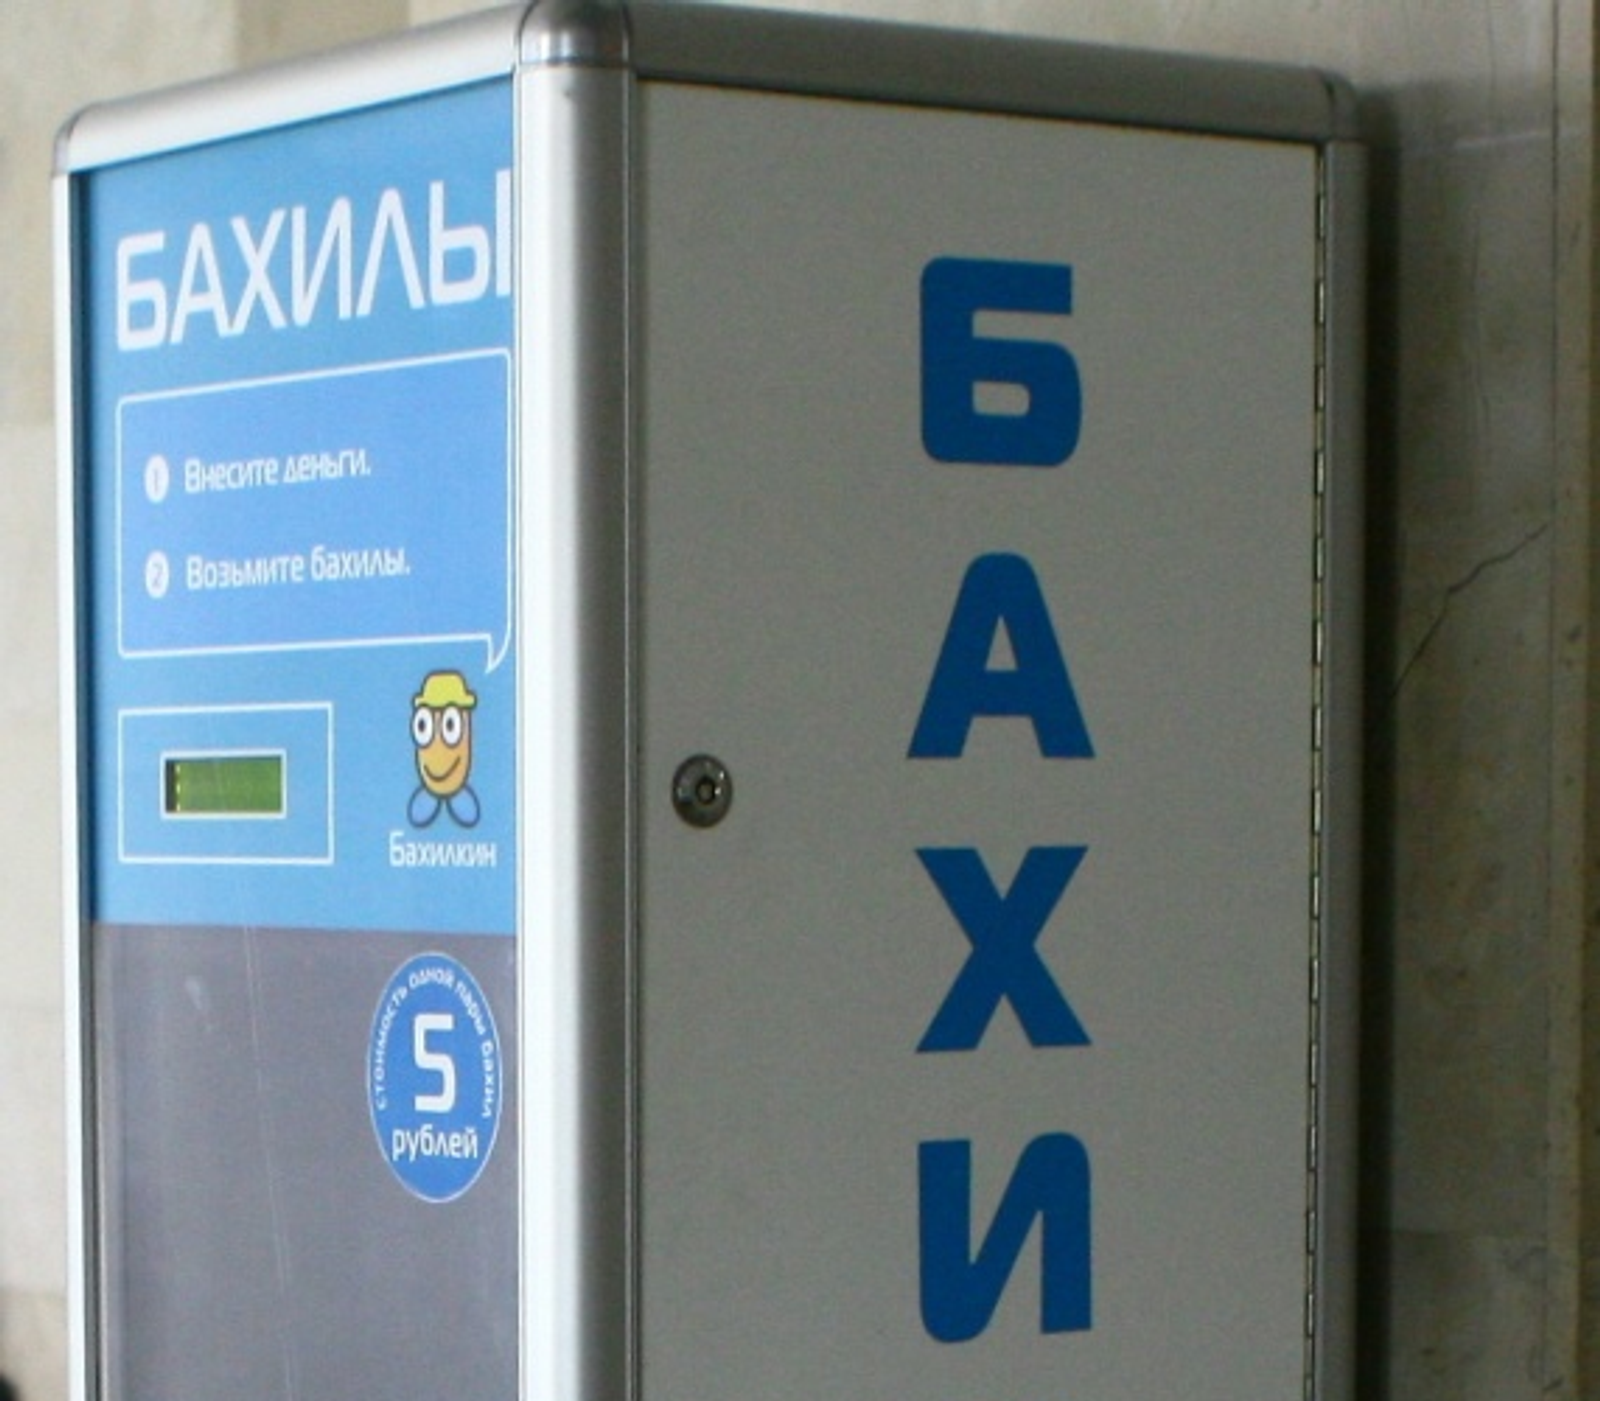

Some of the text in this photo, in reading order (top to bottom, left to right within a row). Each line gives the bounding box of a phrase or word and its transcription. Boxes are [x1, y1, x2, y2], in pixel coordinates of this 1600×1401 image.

[117, 168, 512, 351] БАХИЛЫ
[184, 457, 278, 494] Внесите
[283, 448, 372, 484] деньги.
[186, 554, 304, 592] Возьмите
[311, 544, 411, 582] бахилы.
[389, 830, 497, 868] Бахилкин
[414, 1012, 456, 1114] 5
[392, 1123, 478, 1163] рублей
